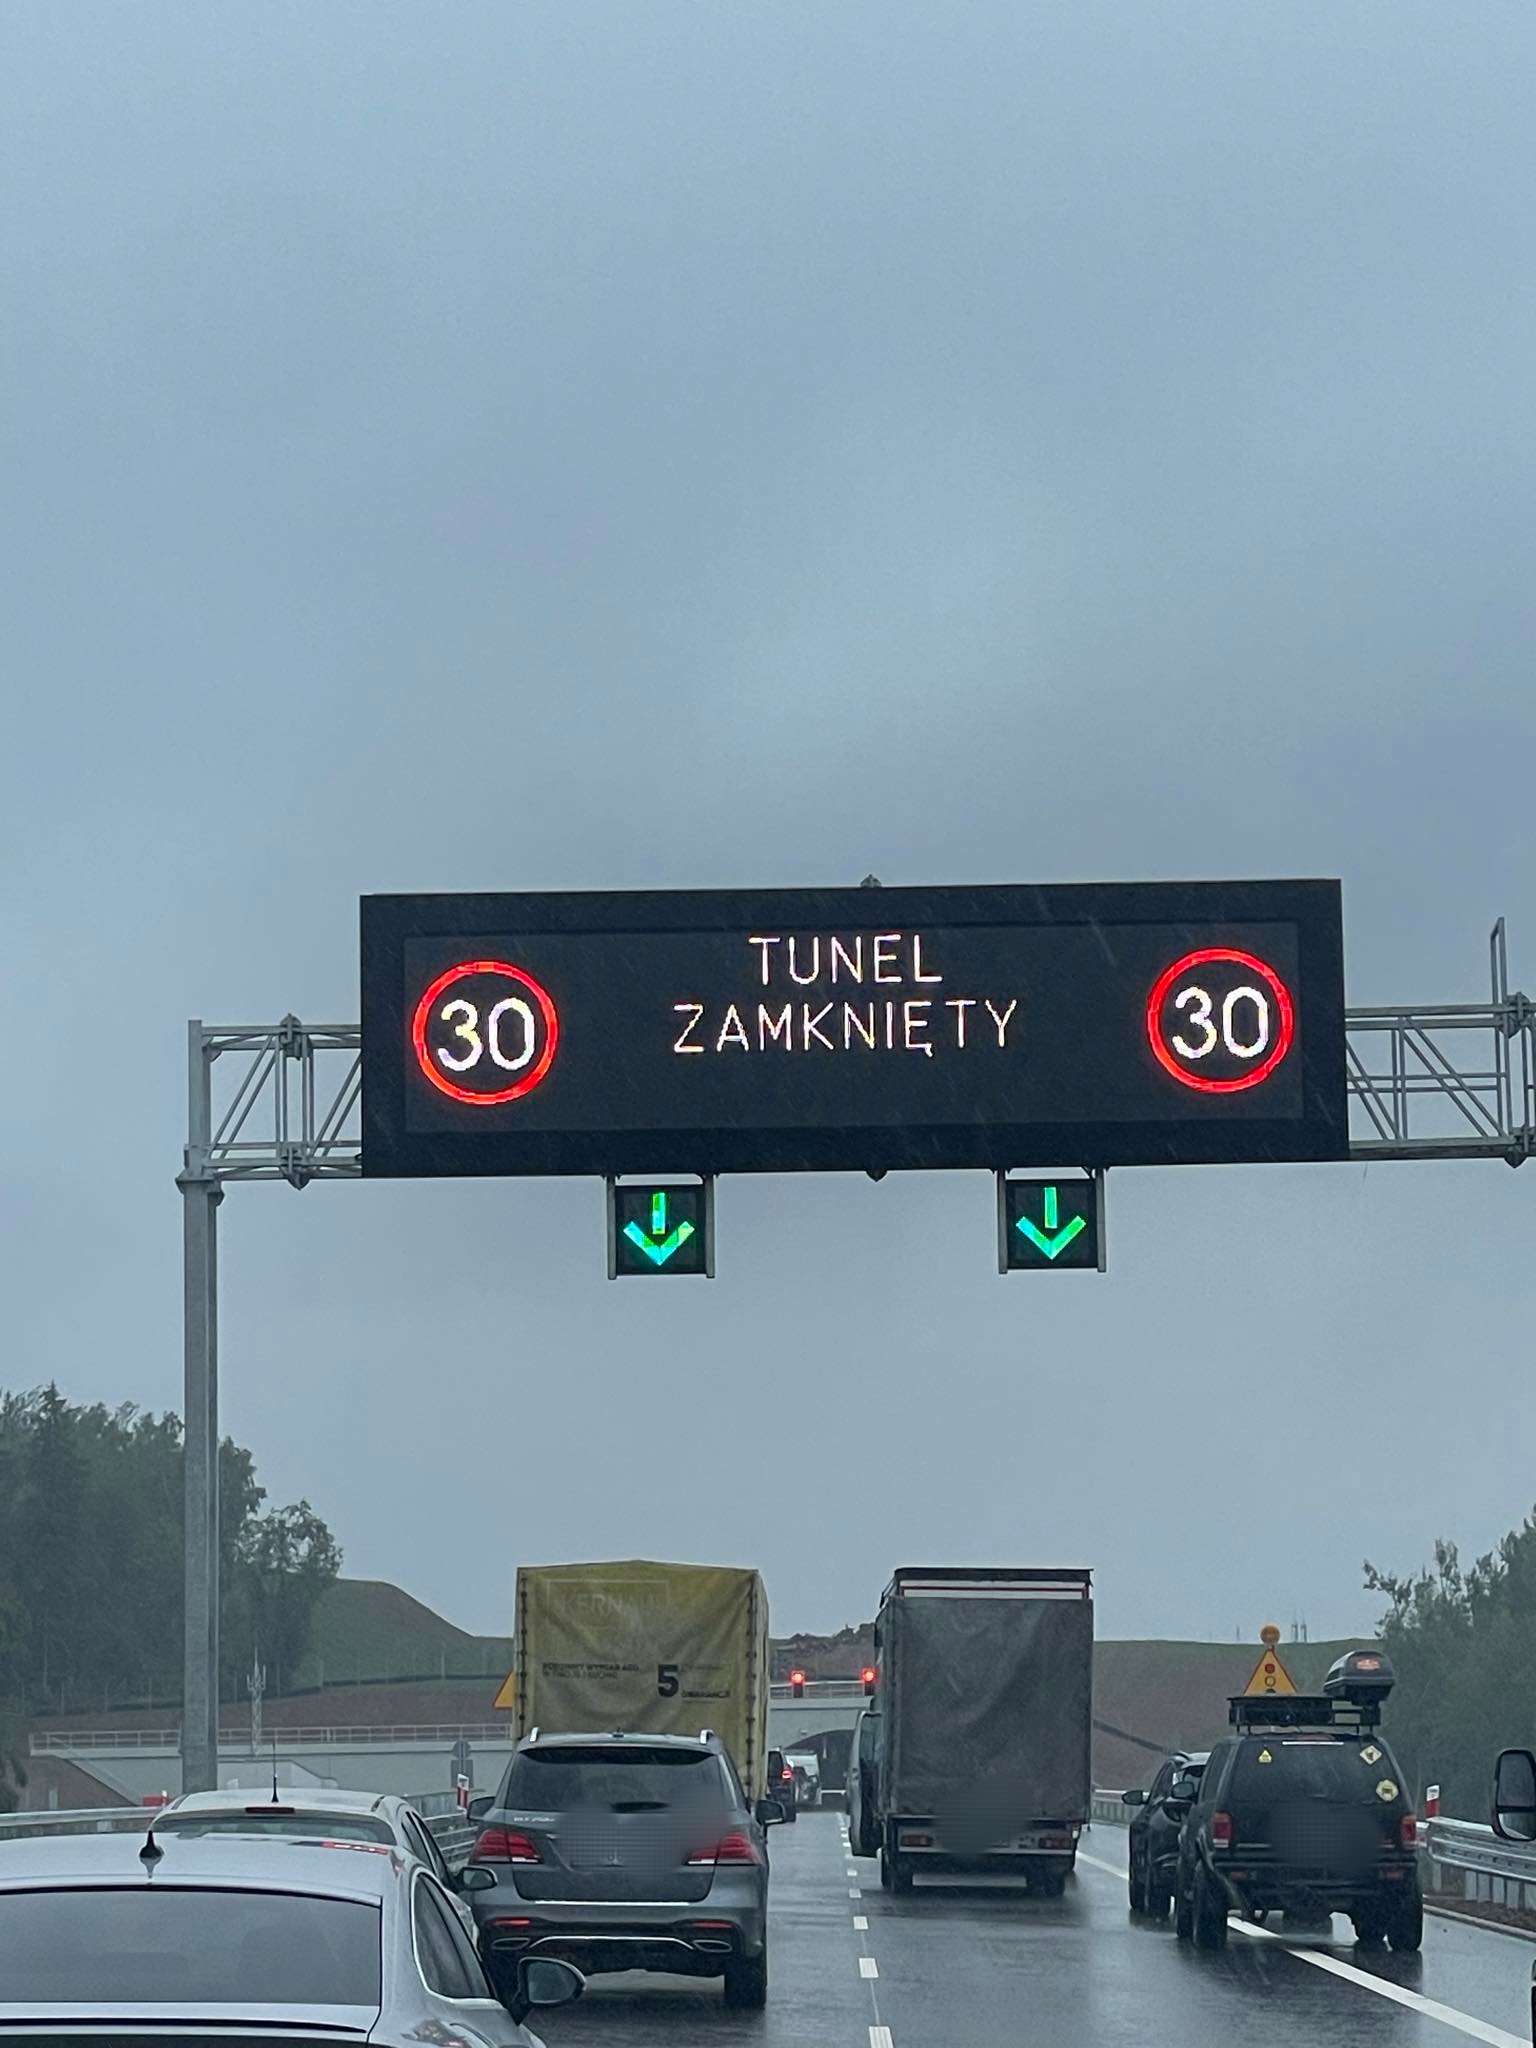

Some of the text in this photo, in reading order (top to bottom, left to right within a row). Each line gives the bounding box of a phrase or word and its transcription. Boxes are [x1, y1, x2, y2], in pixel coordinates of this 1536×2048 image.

[748, 933, 943, 985] TUNEL
[438, 998, 535, 1072] 30
[673, 999, 1017, 1058] ZAMKNIĘTY
[1172, 986, 1269, 1060] 30
[657, 1664, 680, 1698] 5
